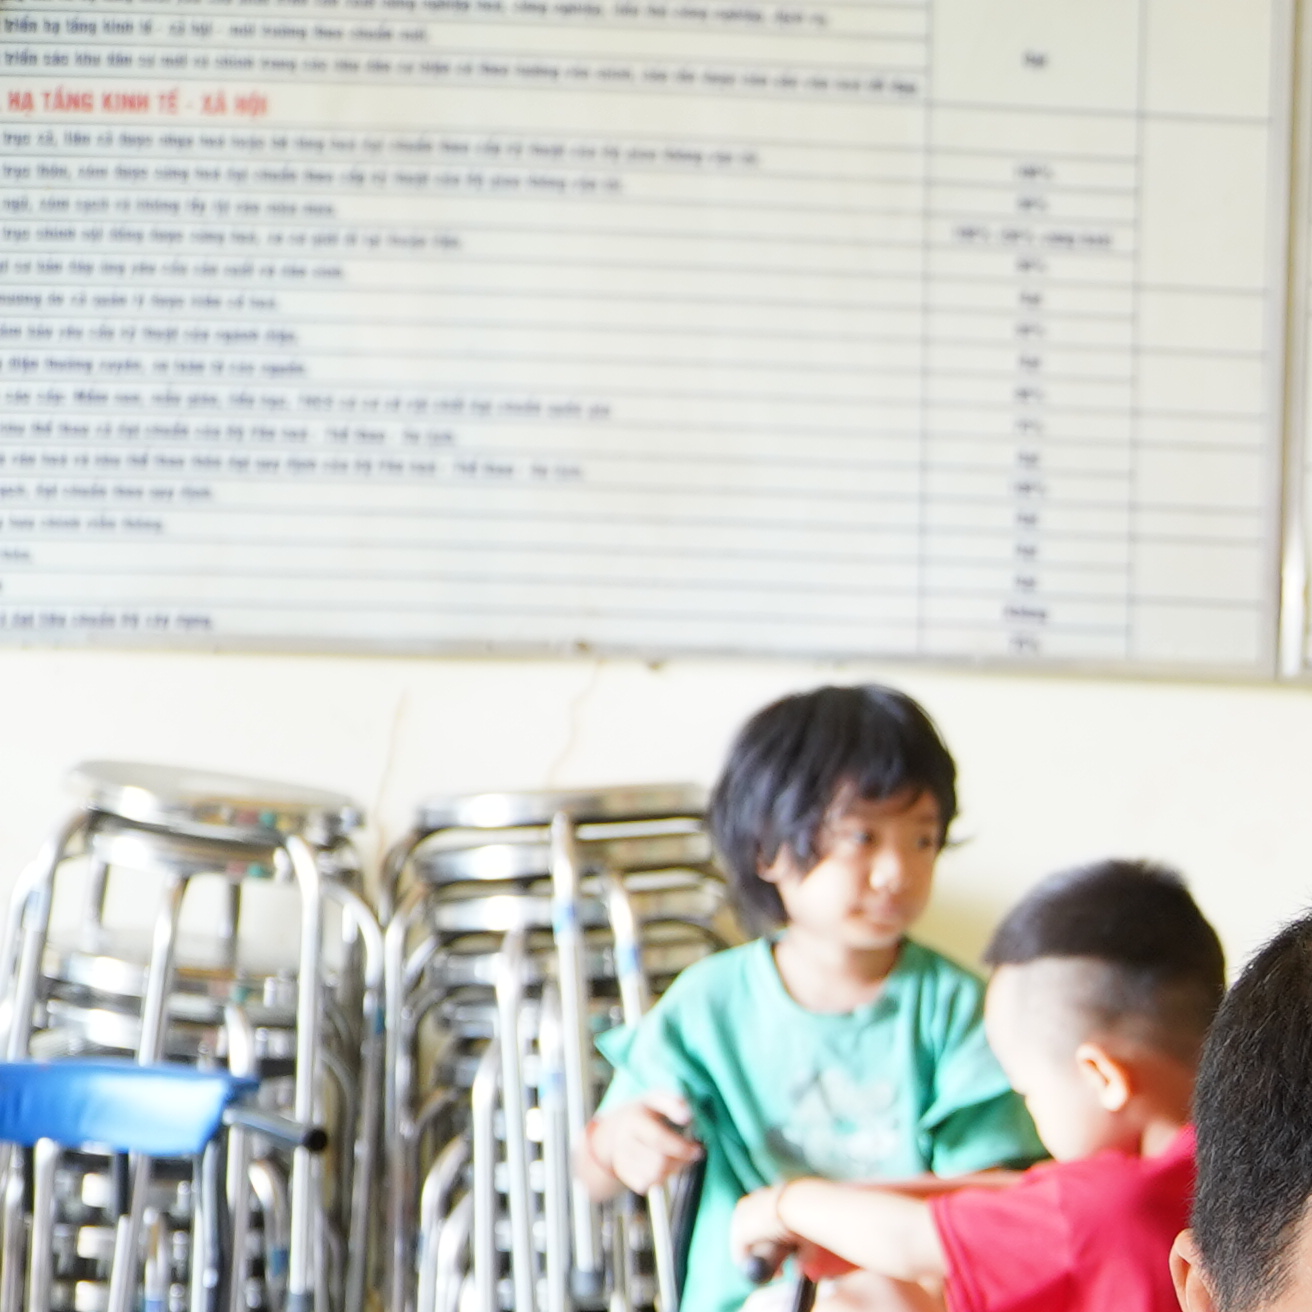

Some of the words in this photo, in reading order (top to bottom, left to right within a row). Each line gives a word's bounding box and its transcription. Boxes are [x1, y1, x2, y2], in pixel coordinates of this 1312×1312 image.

[7, 87, 35, 119] HẠ
[42, 83, 94, 115] TẦNG
[102, 91, 149, 115] KINH
[156, 86, 181, 115] TẾ
